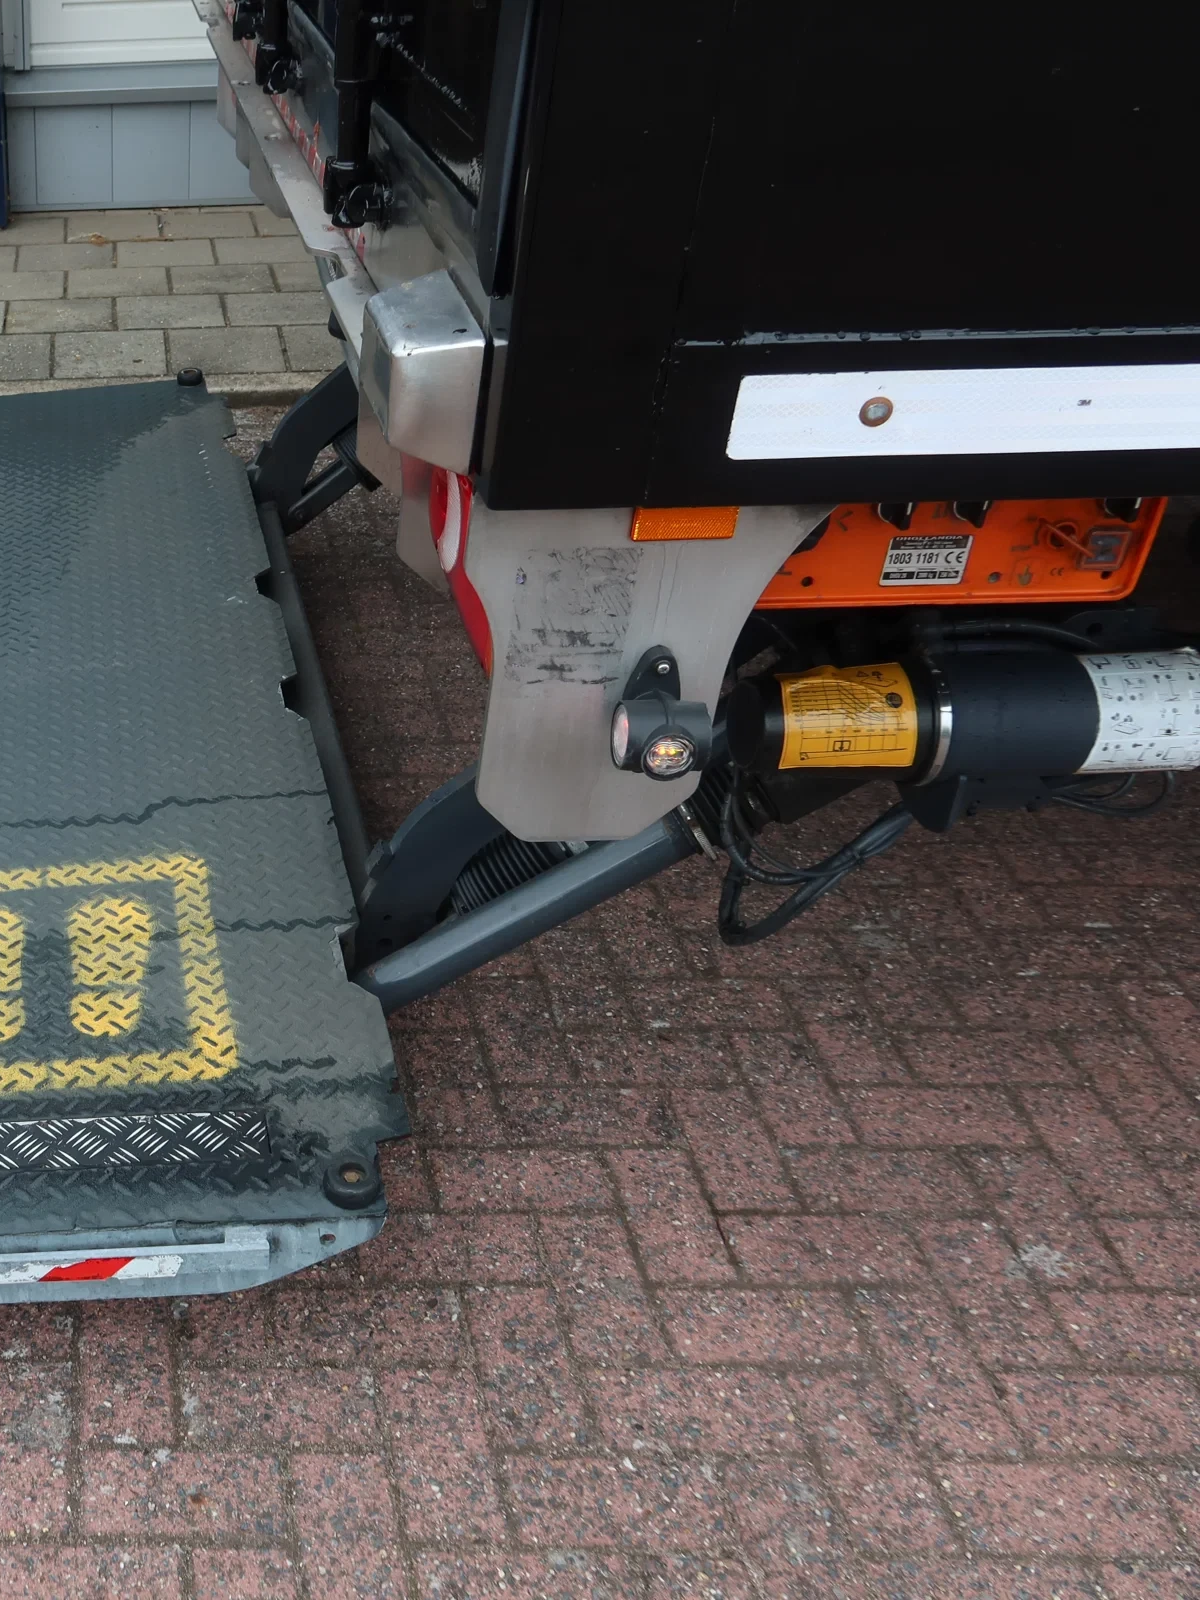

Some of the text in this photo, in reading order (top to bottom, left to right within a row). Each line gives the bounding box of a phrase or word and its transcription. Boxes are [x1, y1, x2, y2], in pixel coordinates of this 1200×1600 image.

[888, 550, 966, 565] 1803 1181 CE
